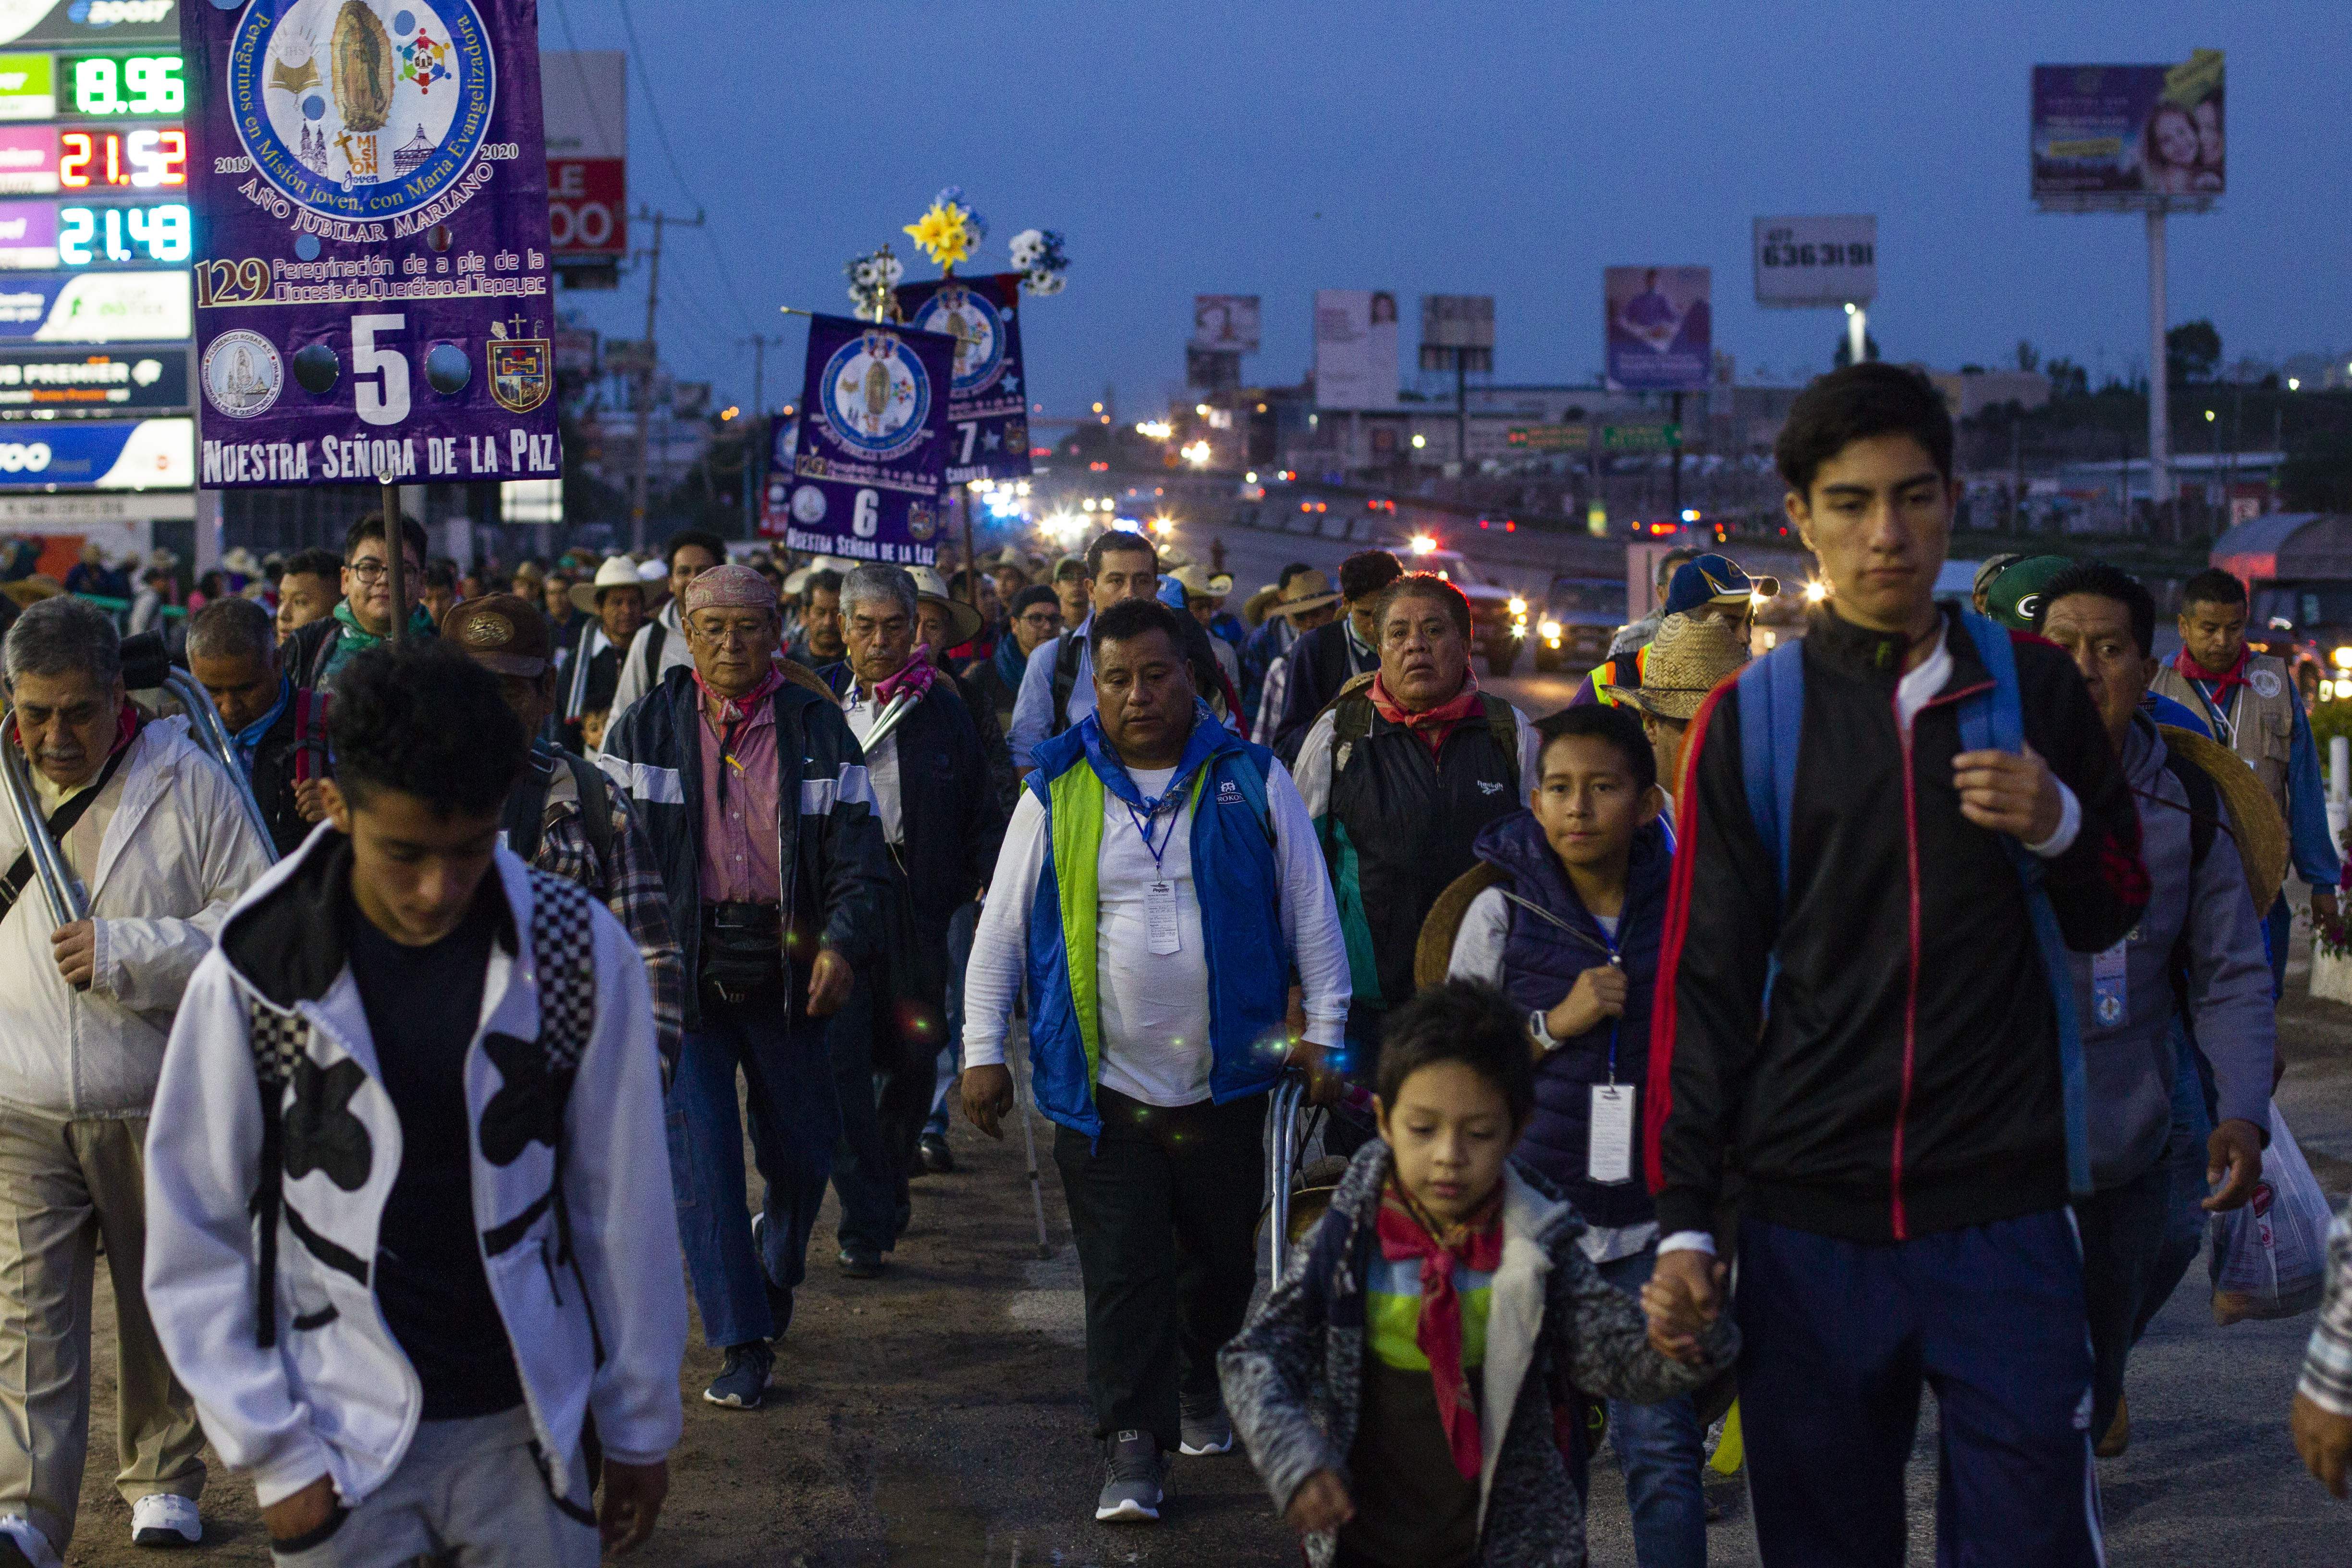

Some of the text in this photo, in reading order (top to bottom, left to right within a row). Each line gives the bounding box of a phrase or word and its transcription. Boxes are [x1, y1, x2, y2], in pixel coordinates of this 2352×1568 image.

[235, 12, 487, 213] Peregrinos en Misión joven, con Maria Evangelizadora
[215, 157, 251, 173] 2019
[480, 143, 518, 159] 2020
[238, 162, 493, 243] AÑO JUBILAR MARIANO
[343, 170, 380, 190] Joven
[195, 257, 270, 306] 129
[273, 248, 544, 282] Peregrinación de a pie de la
[274, 273, 546, 302] Diocesis de Querétaro al Tepeyac
[351, 313, 411, 426] 5
[203, 429, 555, 483] NUESTRA SEÑORA DE LA PAZ
[957, 421, 977, 464] 7
[853, 489, 879, 539] 6
